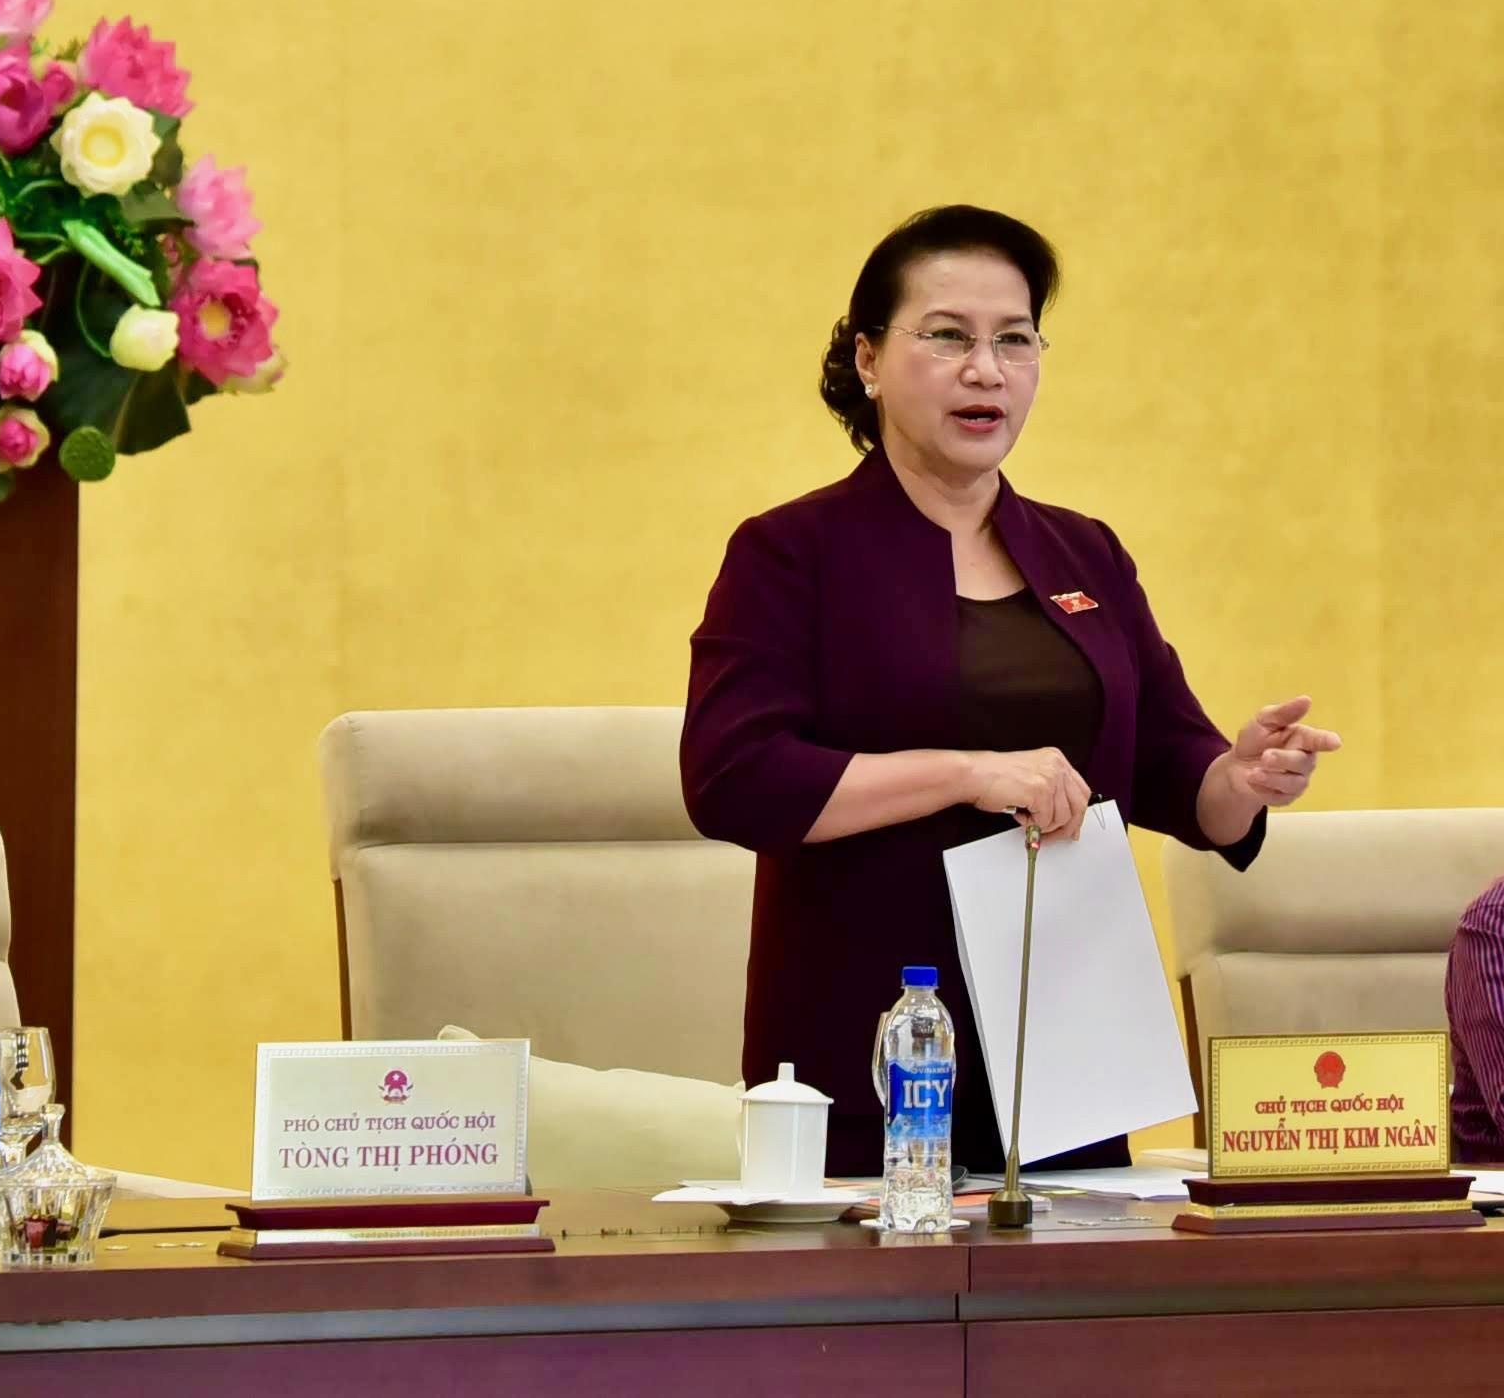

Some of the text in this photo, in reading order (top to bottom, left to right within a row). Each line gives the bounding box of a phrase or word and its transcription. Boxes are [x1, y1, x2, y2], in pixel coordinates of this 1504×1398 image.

[903, 1079, 949, 1109] ICY
[1254, 1092, 1405, 1117] CHỦ TỊCH QUỐC HỘI
[283, 1110, 496, 1134] PHÓ CHỦ TỊCH QUỐC HỘI
[1222, 1118, 1438, 1155] NGUYỄN THỊ KIM NGÂN
[279, 1137, 499, 1172] TÒNG THỊ PHÓNG
